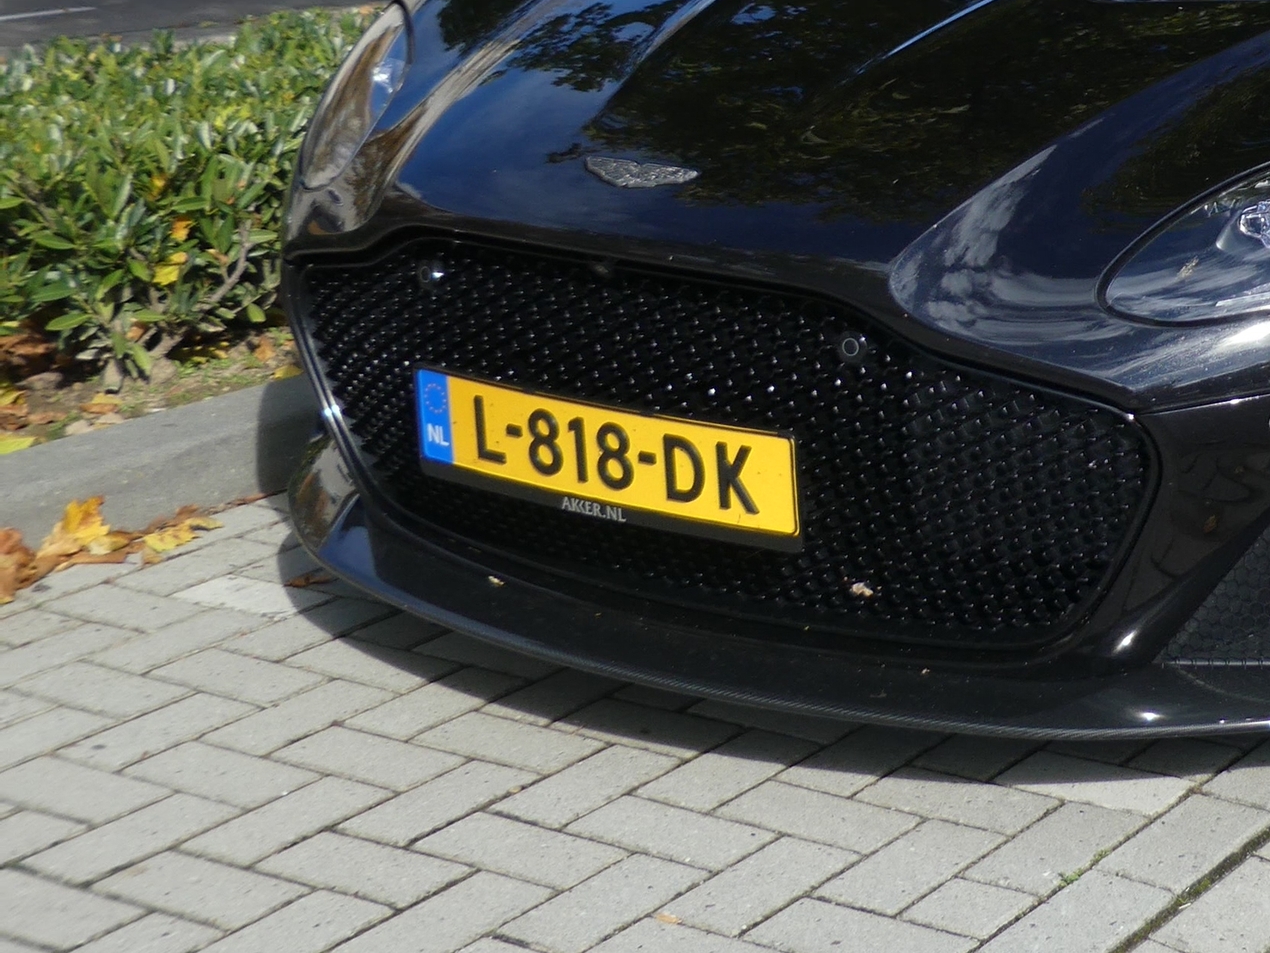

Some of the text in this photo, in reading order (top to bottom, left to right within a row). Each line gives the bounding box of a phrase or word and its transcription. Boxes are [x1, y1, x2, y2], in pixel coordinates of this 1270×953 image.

[427, 423, 450, 447] NL
[473, 394, 759, 514] L-818-DK
[561, 497, 626, 523] AKKER.NL
